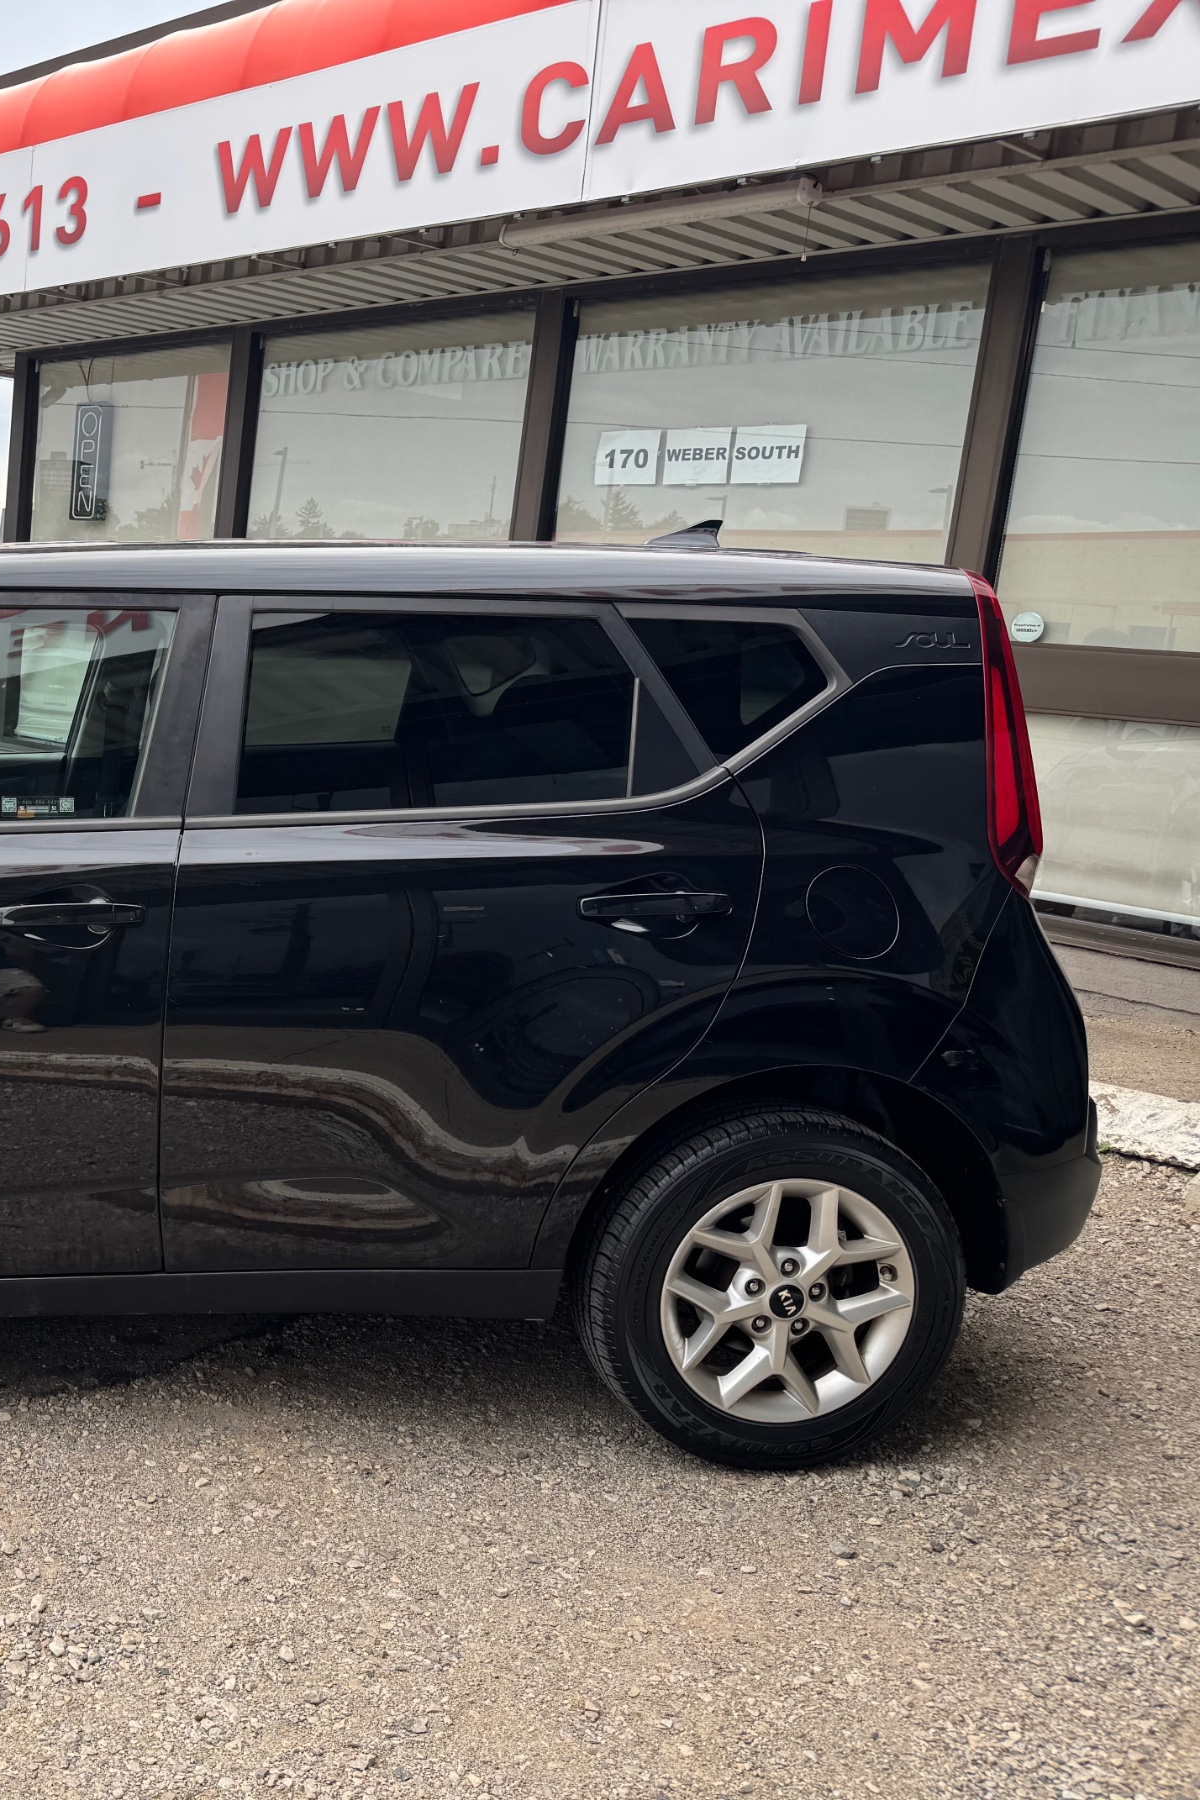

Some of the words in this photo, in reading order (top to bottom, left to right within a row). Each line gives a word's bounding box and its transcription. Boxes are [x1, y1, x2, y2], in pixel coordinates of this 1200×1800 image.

[579, 319, 760, 373] WARRANTY
[766, 301, 973, 360] AVAILABLE
[263, 358, 334, 397] SHOP
[344, 355, 366, 390] &
[376, 340, 528, 388] COMPARE
[77, 411, 98, 512] OPEN
[603, 448, 649, 469] 170
[666, 446, 728, 462] WEBER
[734, 445, 801, 460] SOUTH
[895, 632, 971, 649] SOUL
[742, 1152, 935, 1233] ASSURANCE
[778, 1289, 797, 1316] KIA
